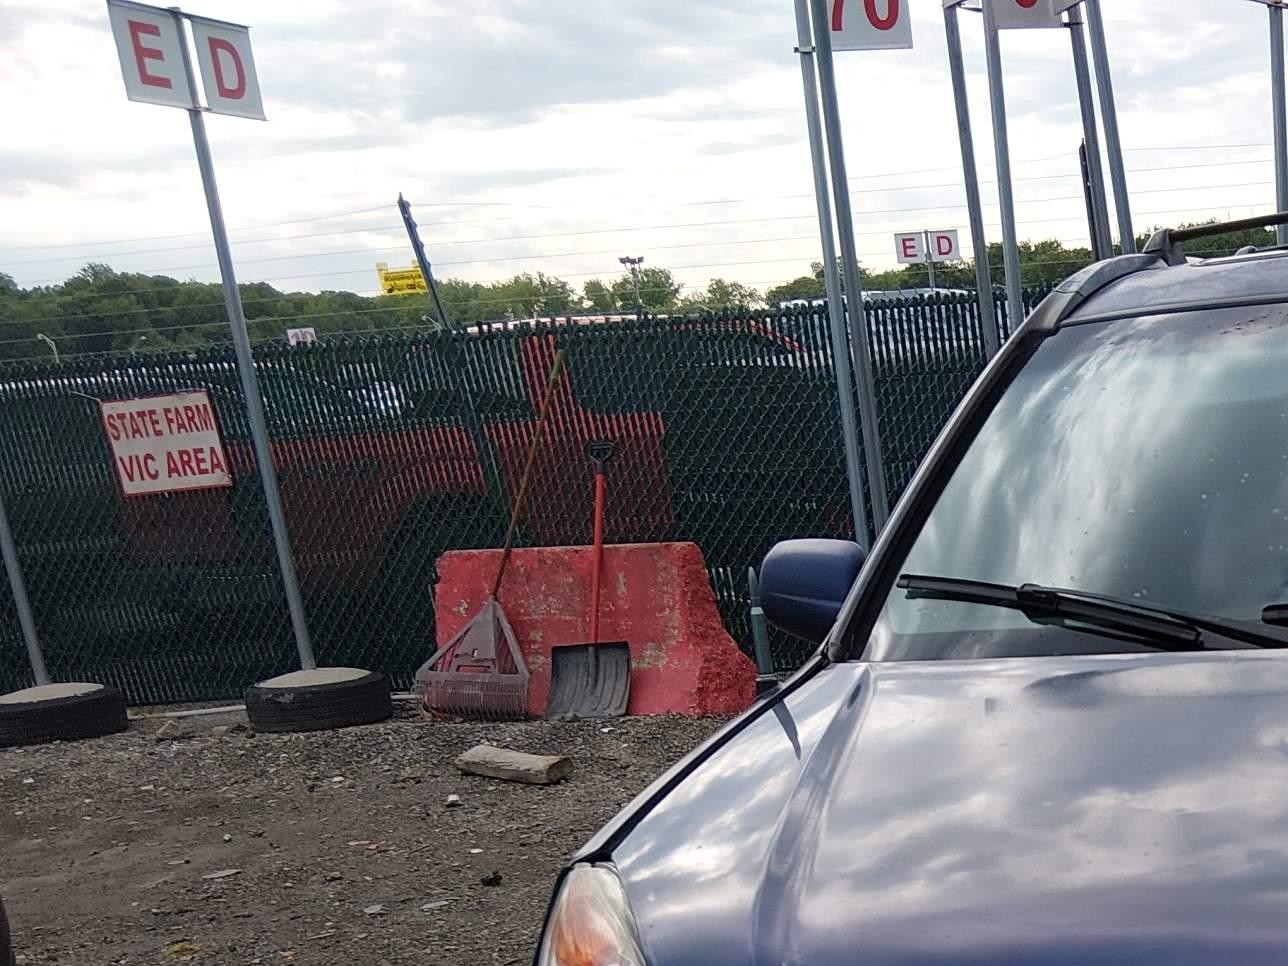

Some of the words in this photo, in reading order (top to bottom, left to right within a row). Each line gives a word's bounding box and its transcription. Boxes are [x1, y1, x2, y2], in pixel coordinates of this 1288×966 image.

[128, 19, 172, 89] E
[208, 36, 246, 100] D
[902, 238, 918, 258] E
[936, 236, 953, 256] D
[106, 409, 163, 441] STATE
[163, 403, 214, 435] FARM
[119, 453, 159, 483] VIC
[166, 447, 226, 479] AREA
